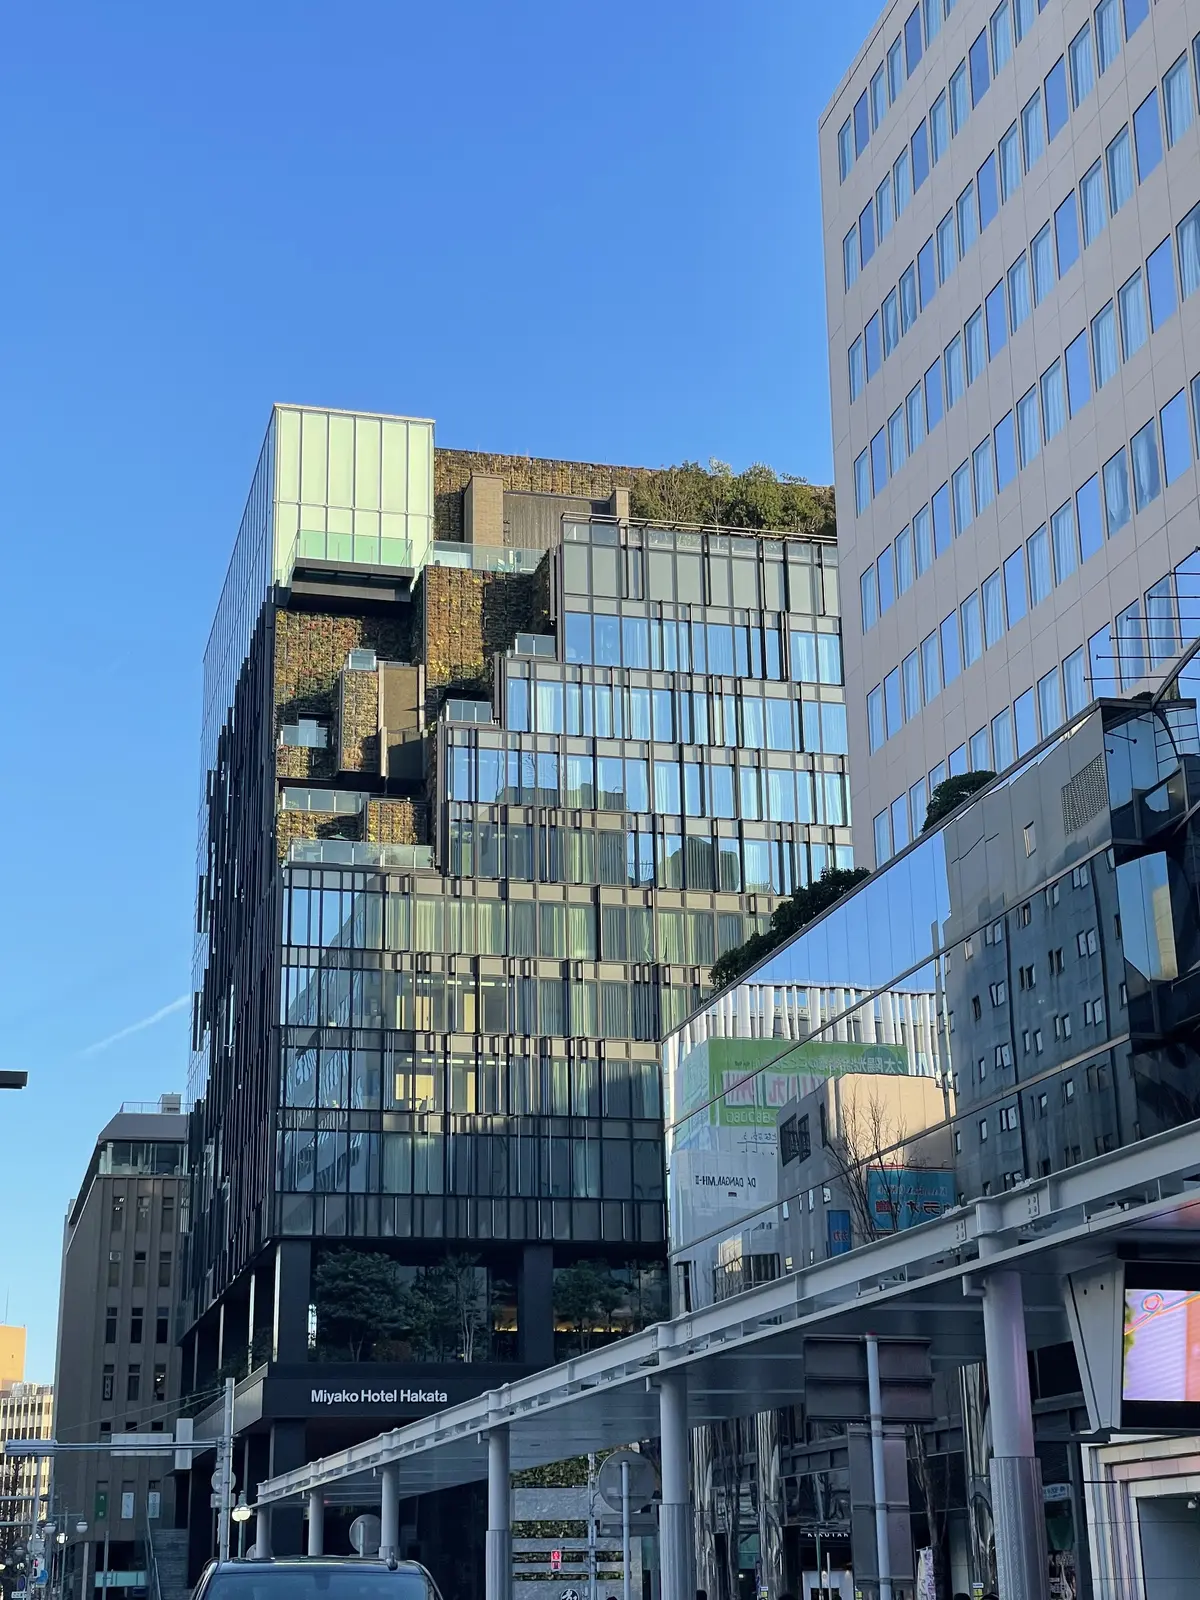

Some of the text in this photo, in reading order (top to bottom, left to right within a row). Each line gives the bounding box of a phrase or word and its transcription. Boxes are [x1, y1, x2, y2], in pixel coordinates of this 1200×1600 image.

[311, 1389, 448, 1405] Miyako Hotel Hakata
